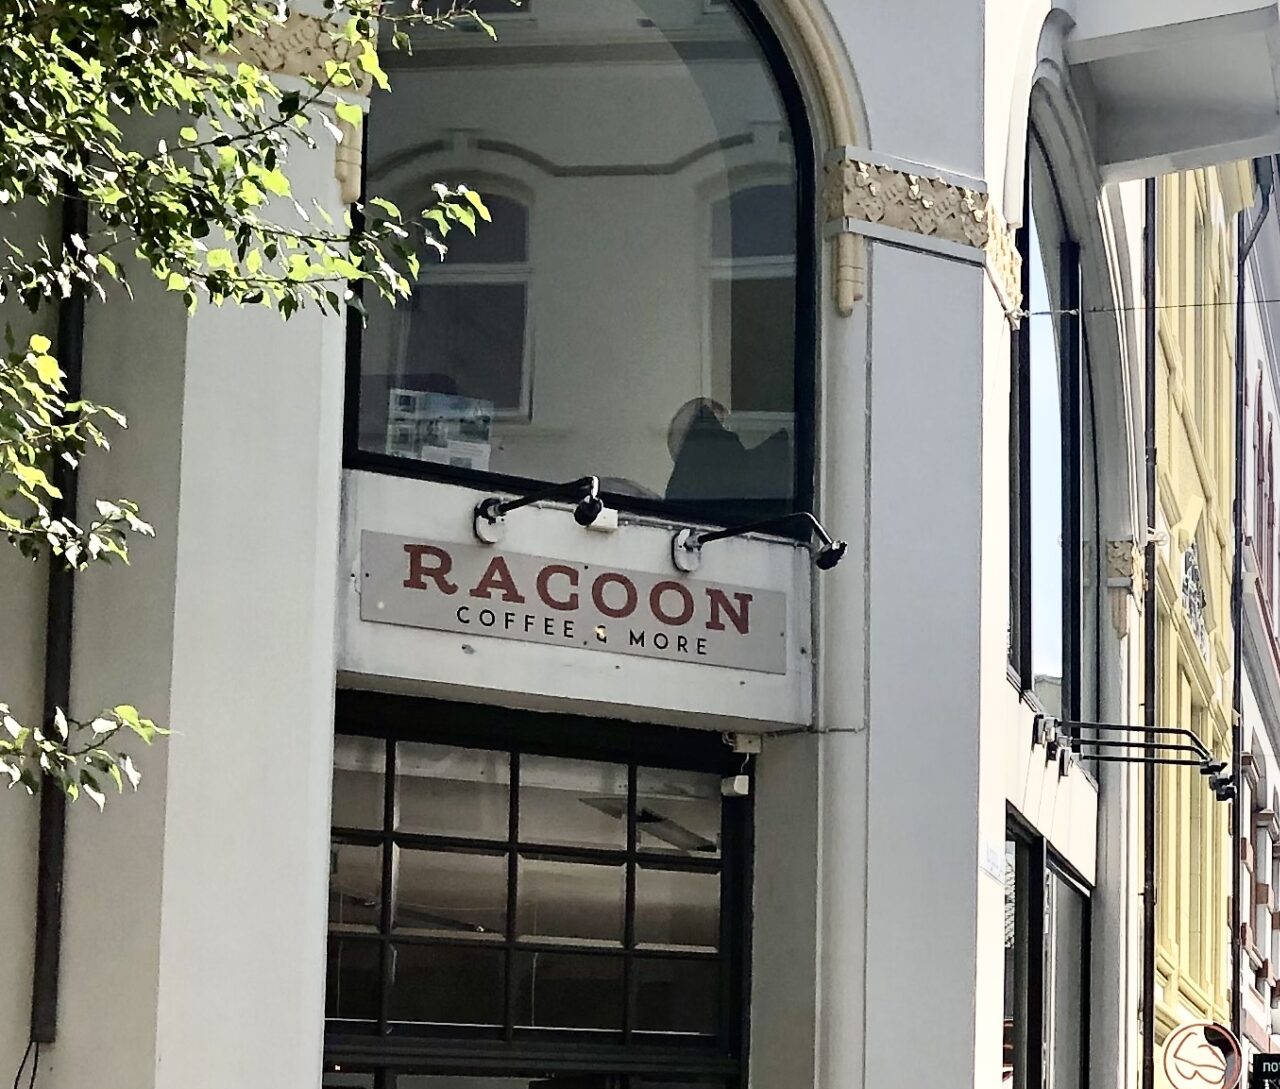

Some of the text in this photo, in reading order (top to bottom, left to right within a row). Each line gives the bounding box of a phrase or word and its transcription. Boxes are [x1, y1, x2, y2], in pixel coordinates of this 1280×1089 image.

[403, 543, 753, 635] RACOON
[456, 605, 575, 638] COFFEE
[629, 630, 707, 655] MORE
